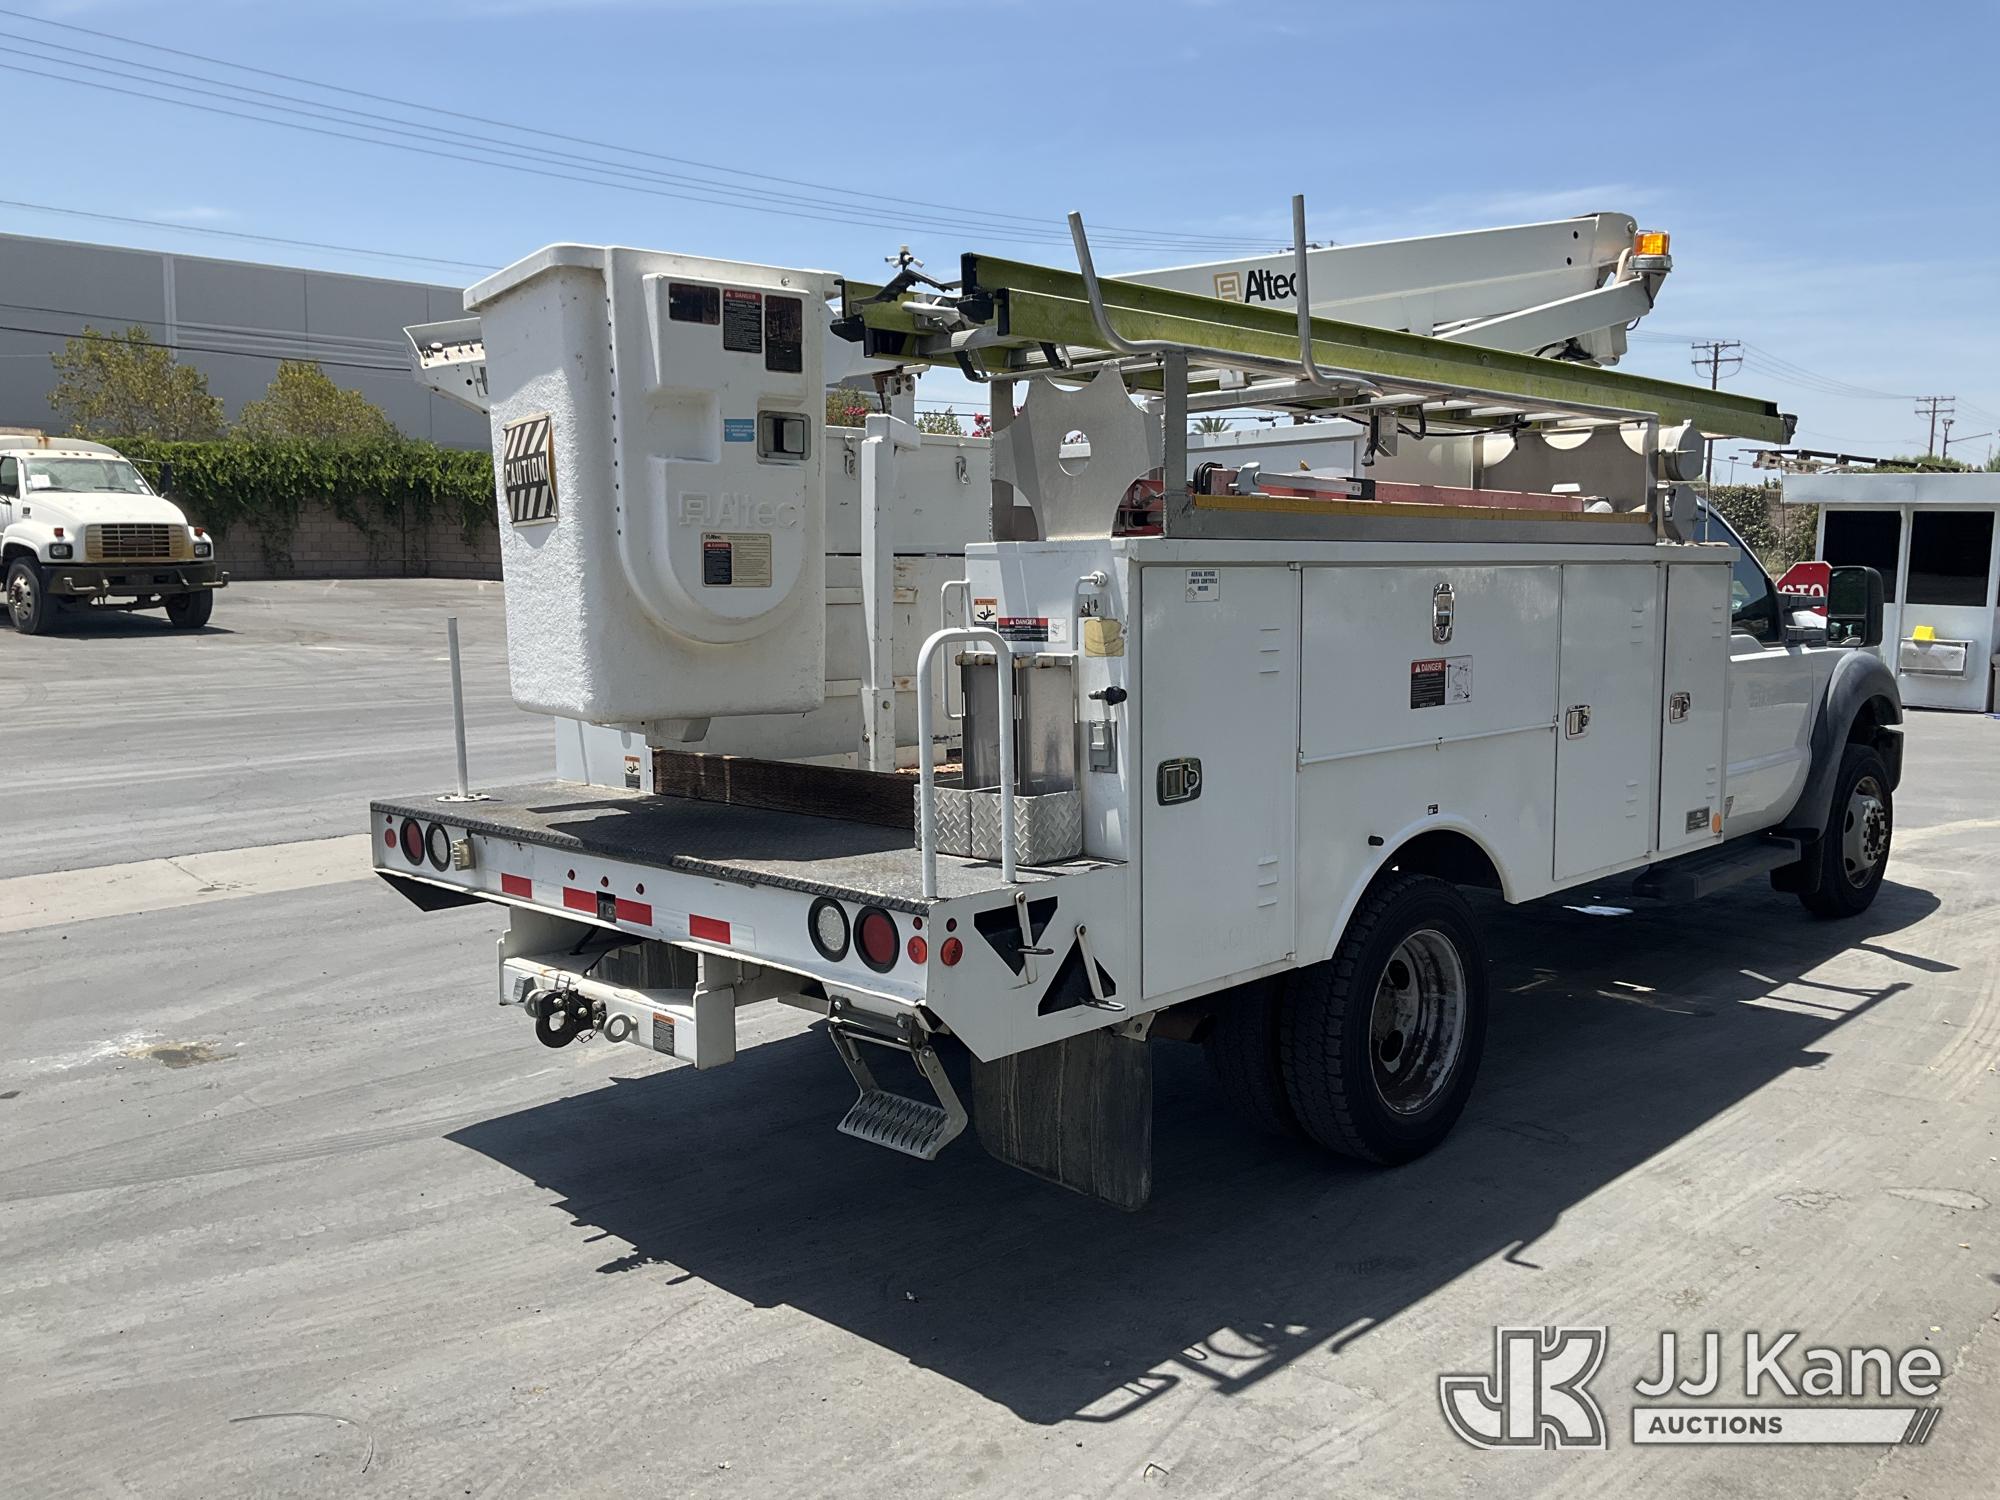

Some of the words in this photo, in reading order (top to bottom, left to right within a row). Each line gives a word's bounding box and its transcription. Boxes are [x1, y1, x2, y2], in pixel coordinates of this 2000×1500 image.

[505, 456, 547, 487] CAUTION
[716, 492, 801, 529] Altec
[1421, 662, 1442, 672] DANGER
